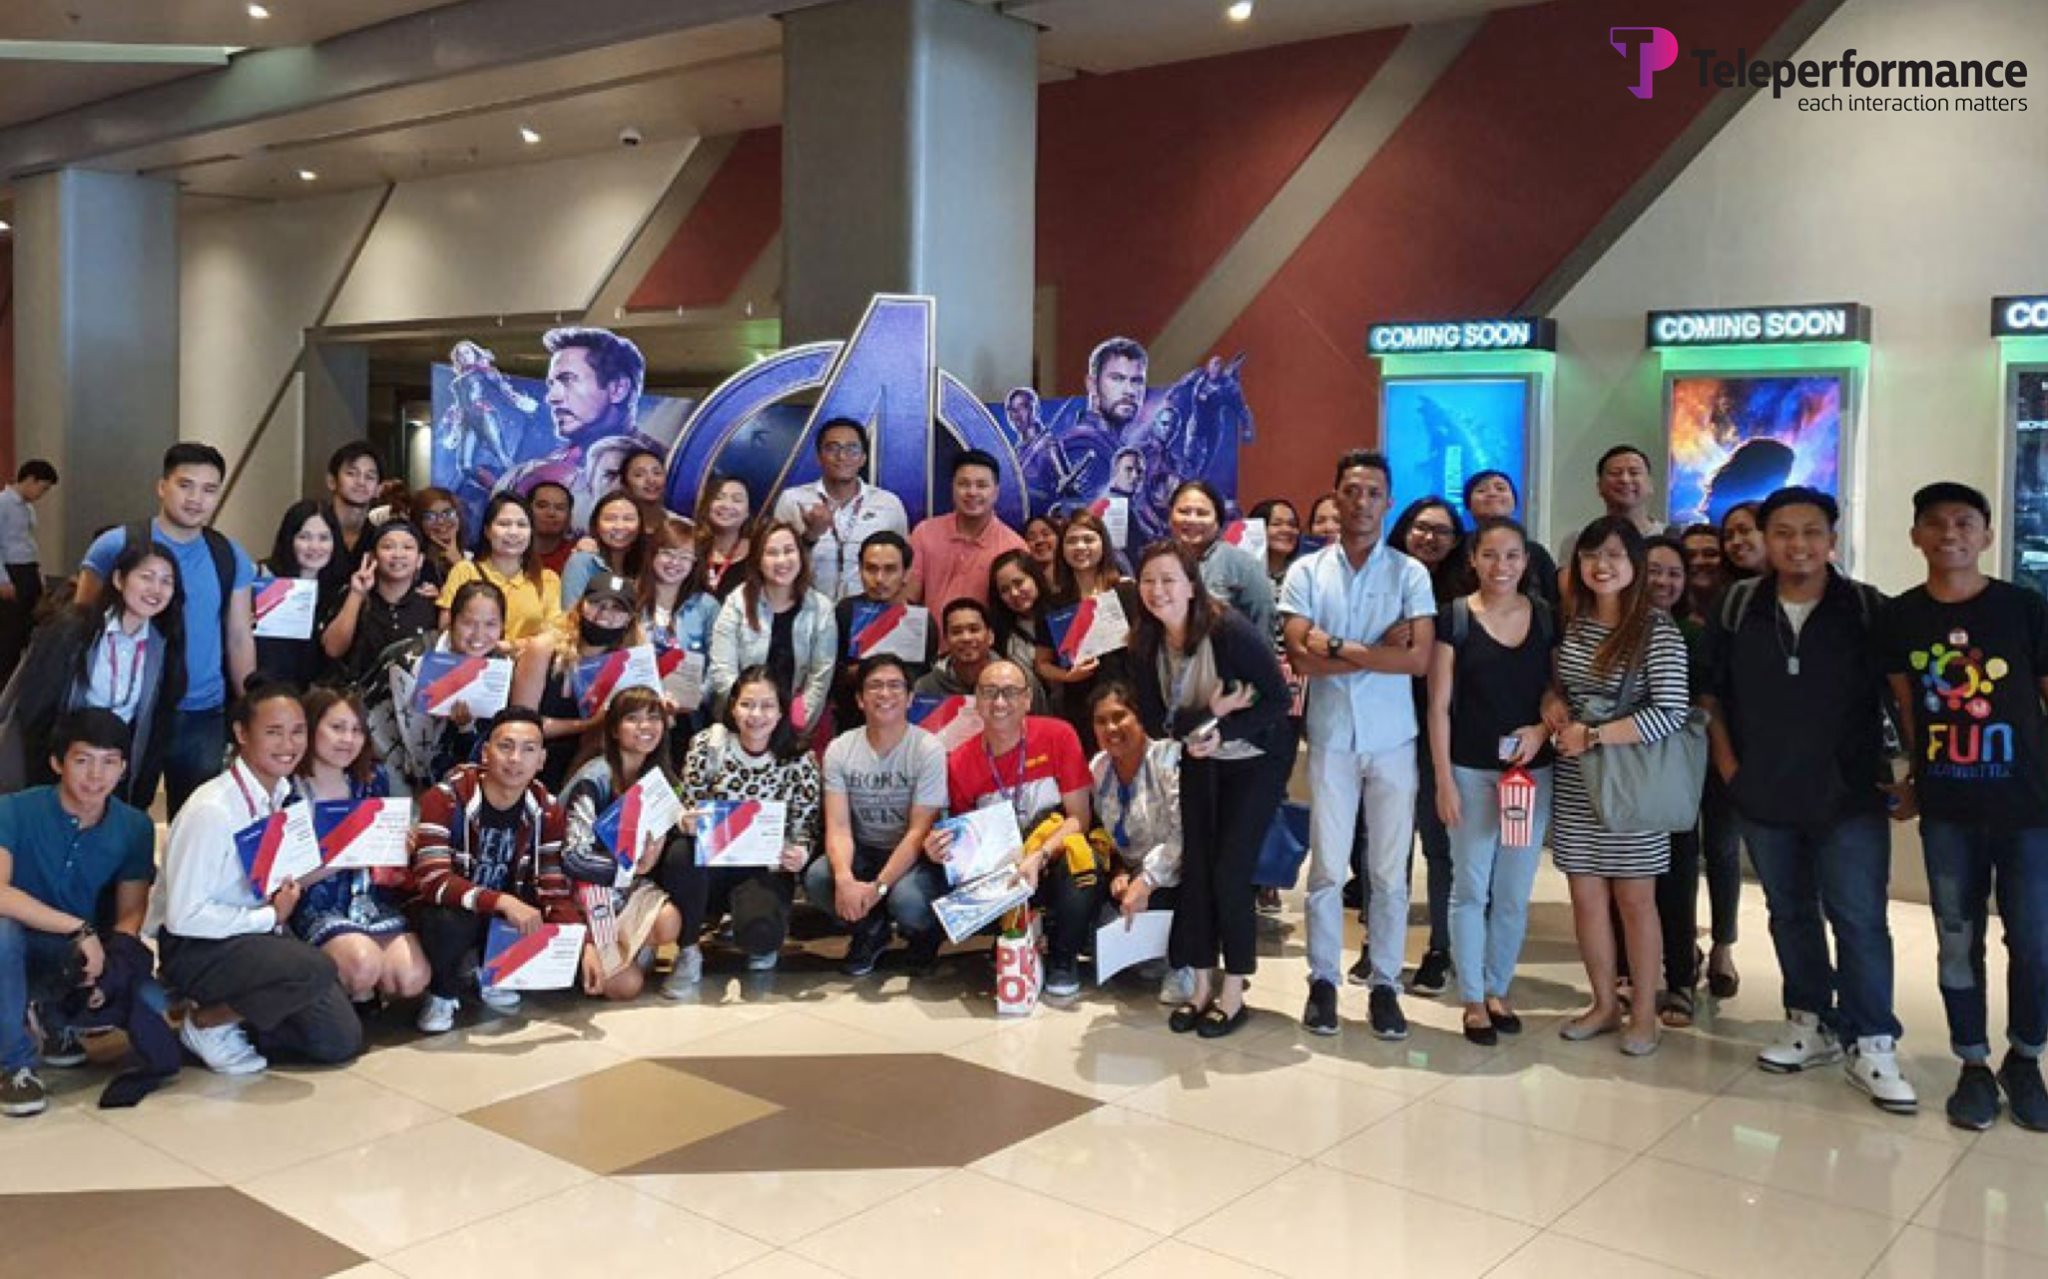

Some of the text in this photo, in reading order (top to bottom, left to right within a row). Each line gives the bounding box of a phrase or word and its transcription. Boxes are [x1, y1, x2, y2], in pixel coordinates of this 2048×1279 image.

[1374, 323, 1530, 349] COMING SOON
[1659, 310, 1846, 341] COMING SOON
